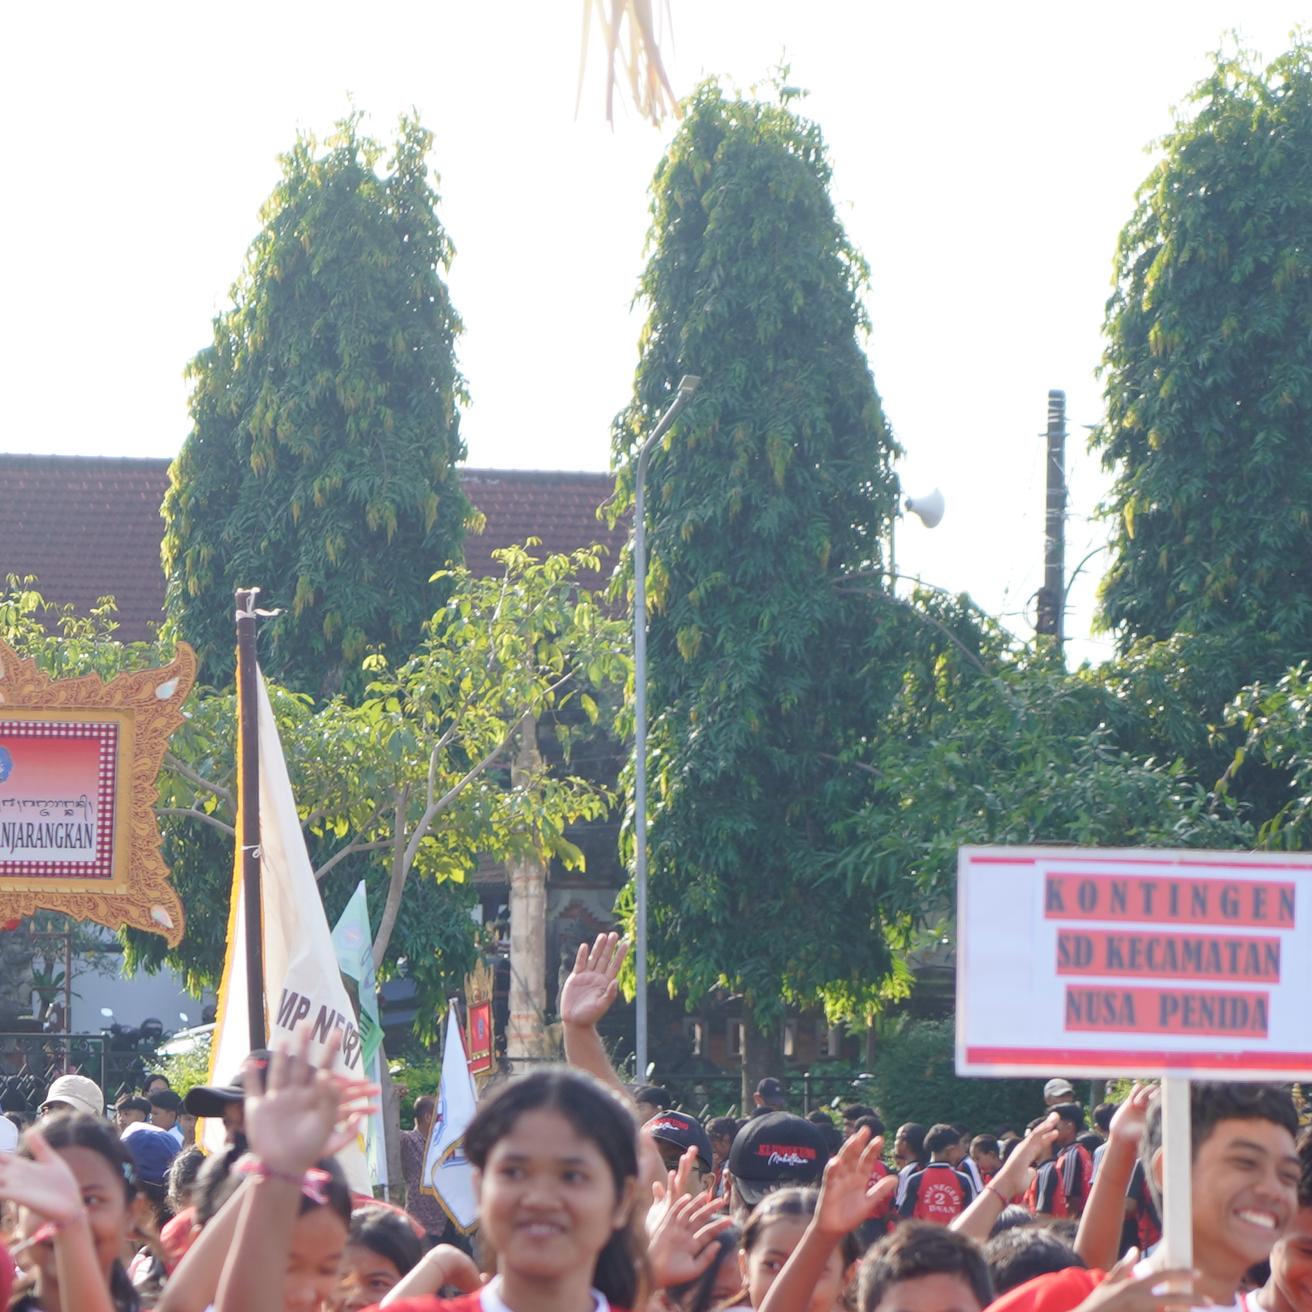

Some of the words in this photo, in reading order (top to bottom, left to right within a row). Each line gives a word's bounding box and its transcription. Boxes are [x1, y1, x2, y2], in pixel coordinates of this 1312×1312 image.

[1045, 878, 1296, 921] KONTINGEN
[1057, 935, 1094, 968] SD
[1106, 936, 1280, 977] KECAMATAN
[1066, 990, 1135, 1027] NUSA
[1159, 993, 1268, 1032] PENIDA
[934, 1192, 946, 1205] 2
